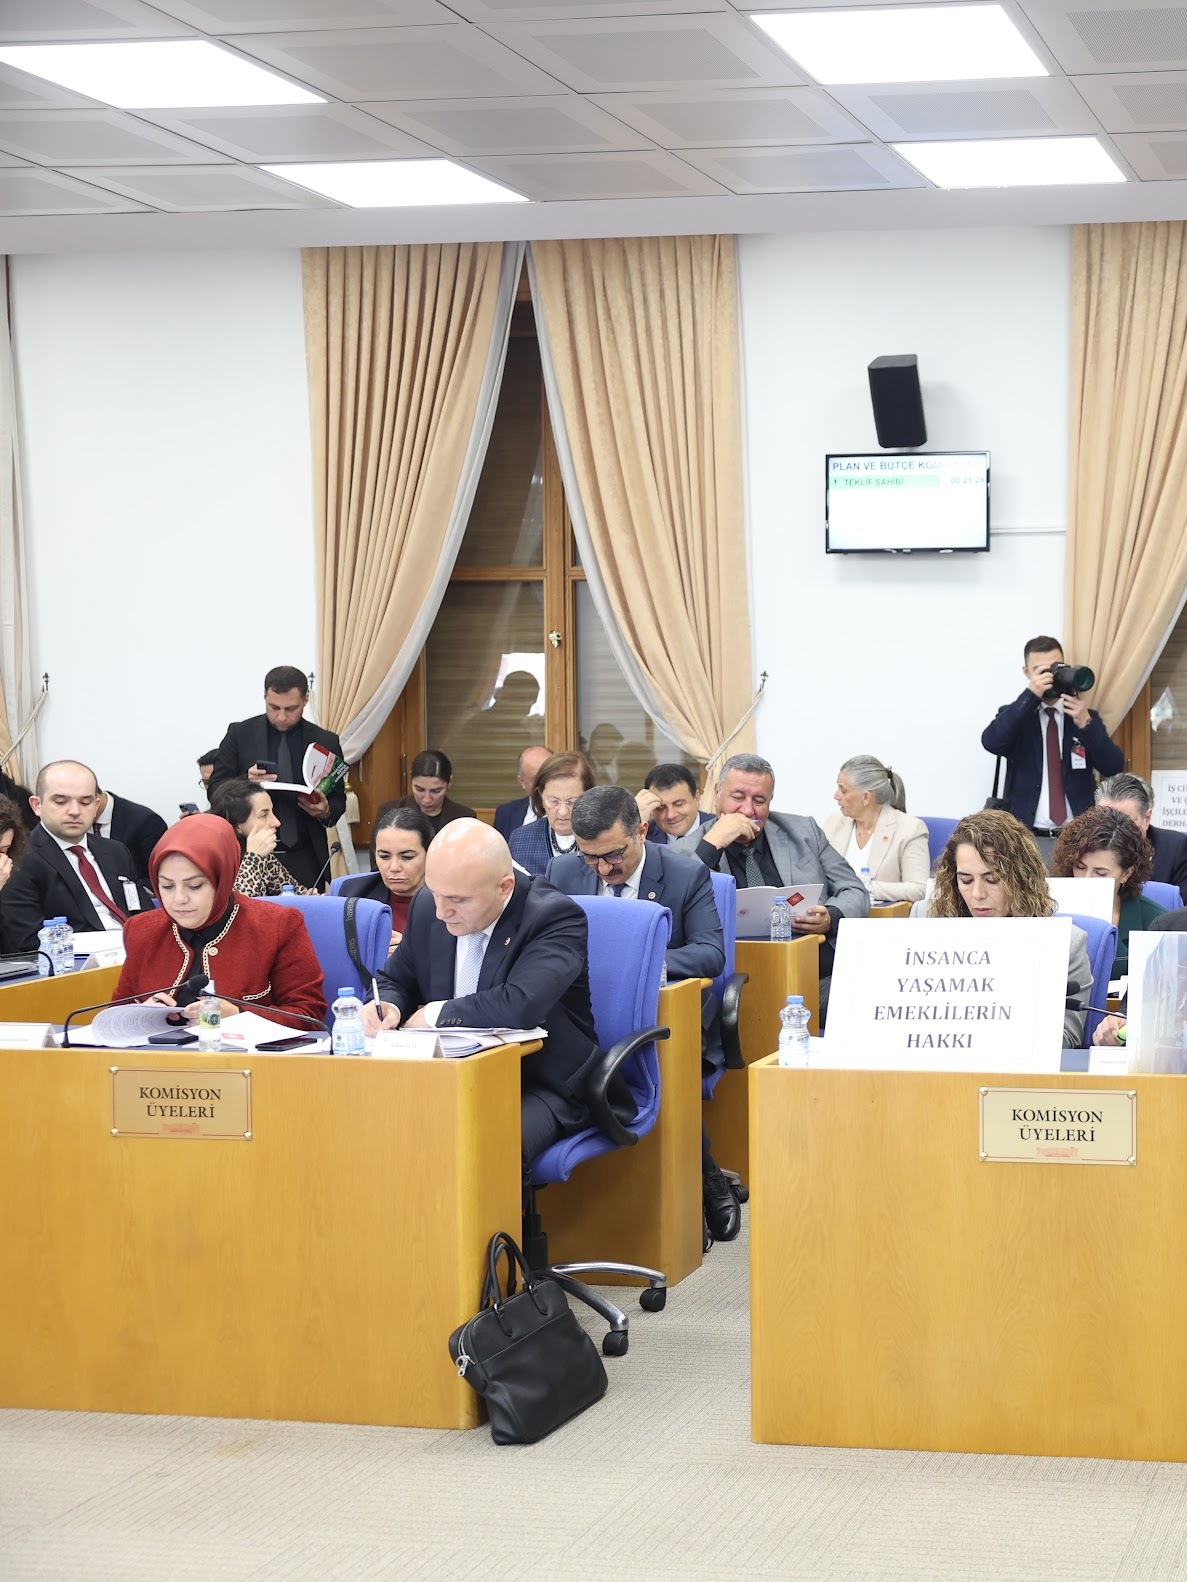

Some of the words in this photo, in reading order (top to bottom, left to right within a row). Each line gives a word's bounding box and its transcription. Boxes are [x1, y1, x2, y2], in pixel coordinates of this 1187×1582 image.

[832, 462, 860, 471] PLAN
[864, 461, 877, 470] VE
[880, 459, 914, 471] BÜTÇE
[844, 477, 874, 486] TEKLİF
[875, 477, 904, 486] SAHİBİ
[1168, 784, 1175, 793] İŞ
[904, 948, 992, 965] İNSANCA
[897, 977, 995, 996] YAŞAMAK
[873, 1002, 1012, 1020] EMEKLİLERİN
[906, 1033, 973, 1048] HAKKI
[139, 1084, 222, 1101] KOMİSYON
[146, 1102, 215, 1118] ÜYELERİ
[1012, 1106, 1103, 1123] KOMİSYON
[1019, 1125, 1096, 1142] ÜYELERİ
